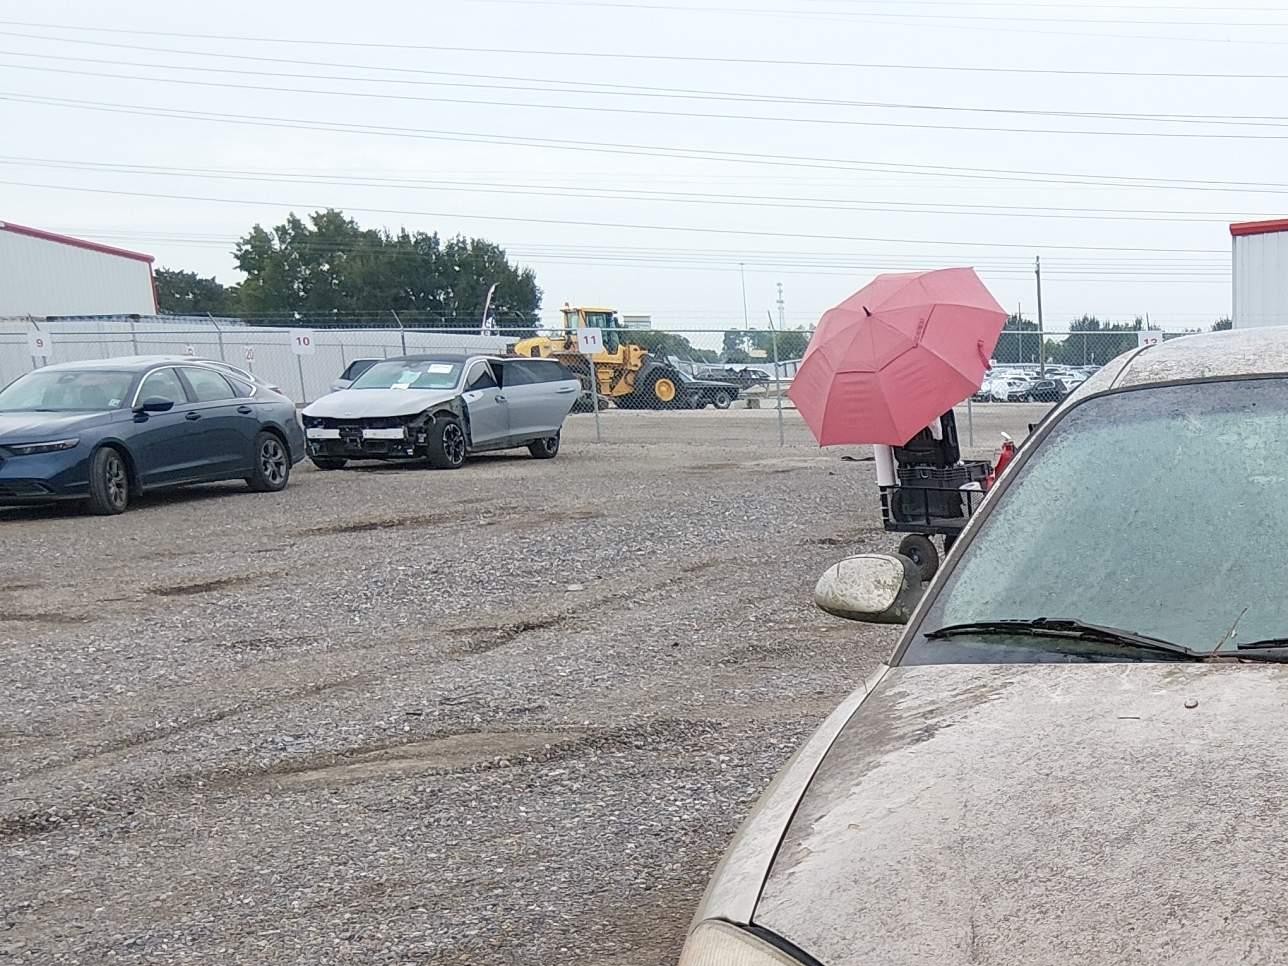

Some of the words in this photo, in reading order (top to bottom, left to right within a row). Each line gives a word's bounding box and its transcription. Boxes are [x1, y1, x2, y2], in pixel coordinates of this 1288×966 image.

[35, 338, 44, 348] 9
[296, 336, 310, 346] 10
[583, 335, 597, 345] 11
